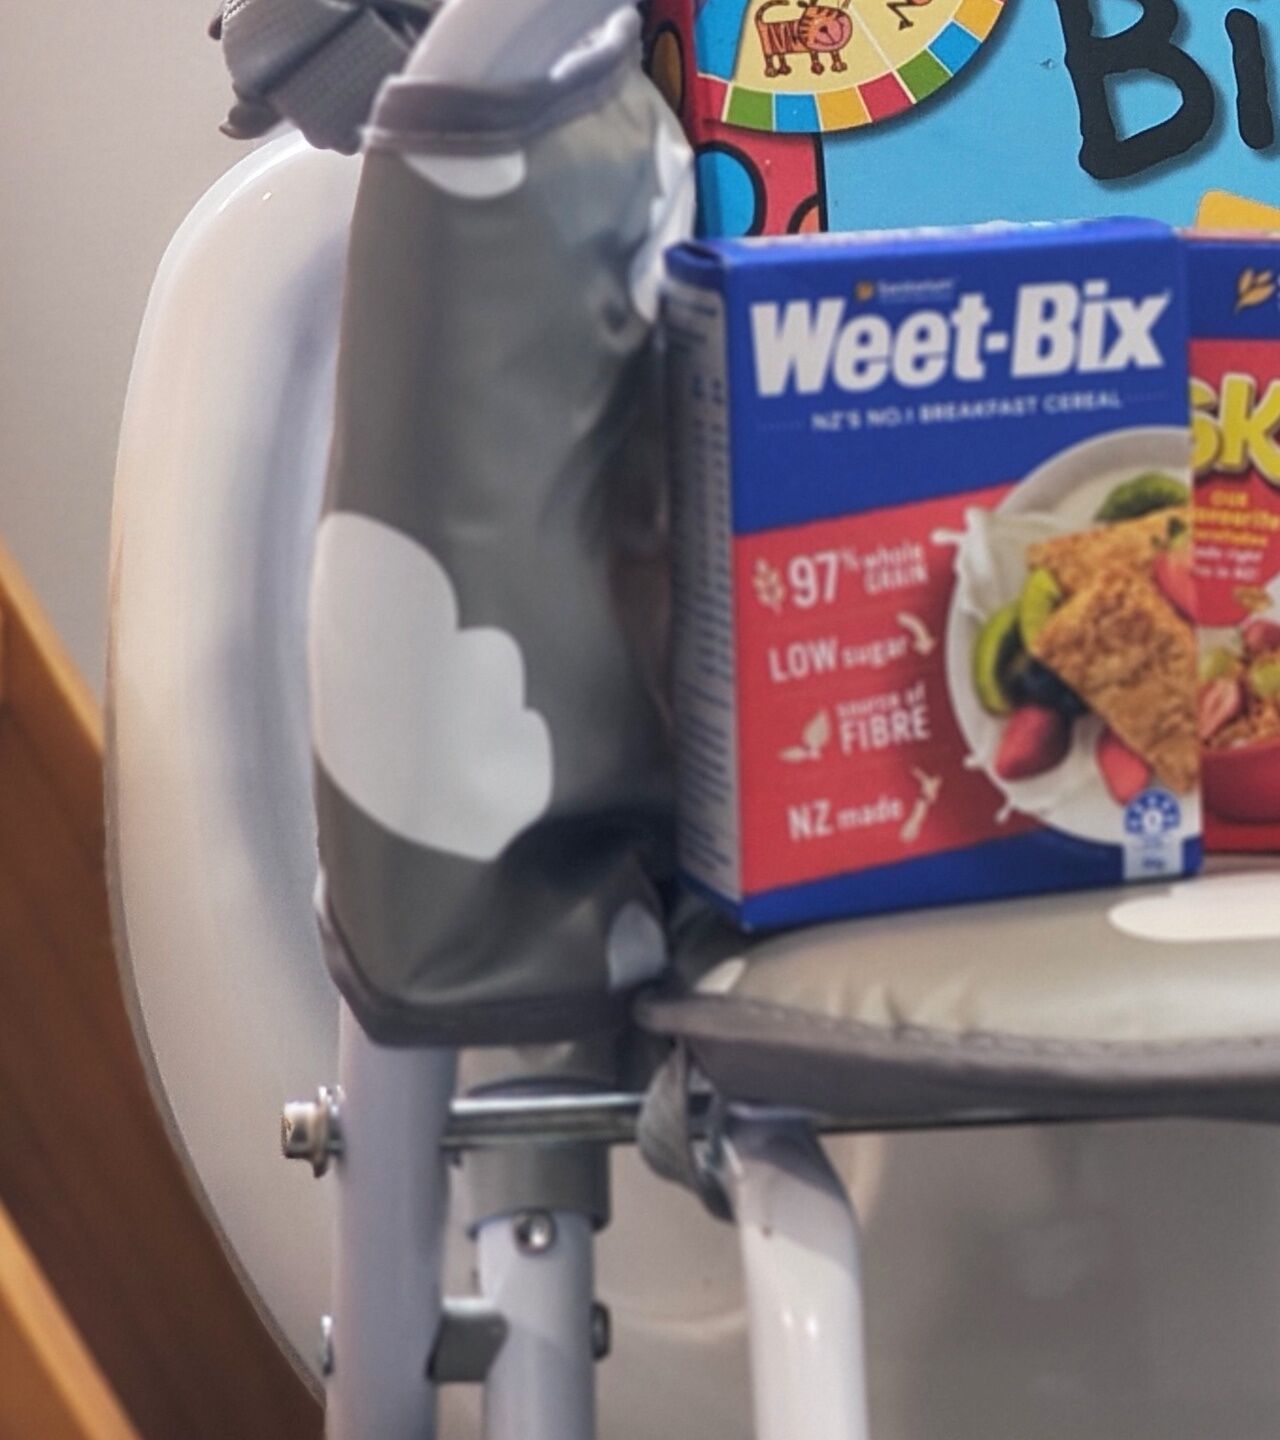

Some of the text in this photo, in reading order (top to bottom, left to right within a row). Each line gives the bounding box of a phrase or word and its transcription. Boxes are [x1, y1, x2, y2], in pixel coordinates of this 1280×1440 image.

[750, 279, 1168, 398] Weet-Bix
[812, 409, 860, 430] NZ'S
[920, 397, 1037, 422] BREAKFAST
[1043, 391, 1121, 413] CEREAL
[768, 636, 908, 683] LOW sugar
[839, 707, 931, 754] FIBRE
[788, 796, 903, 843] NZ made
